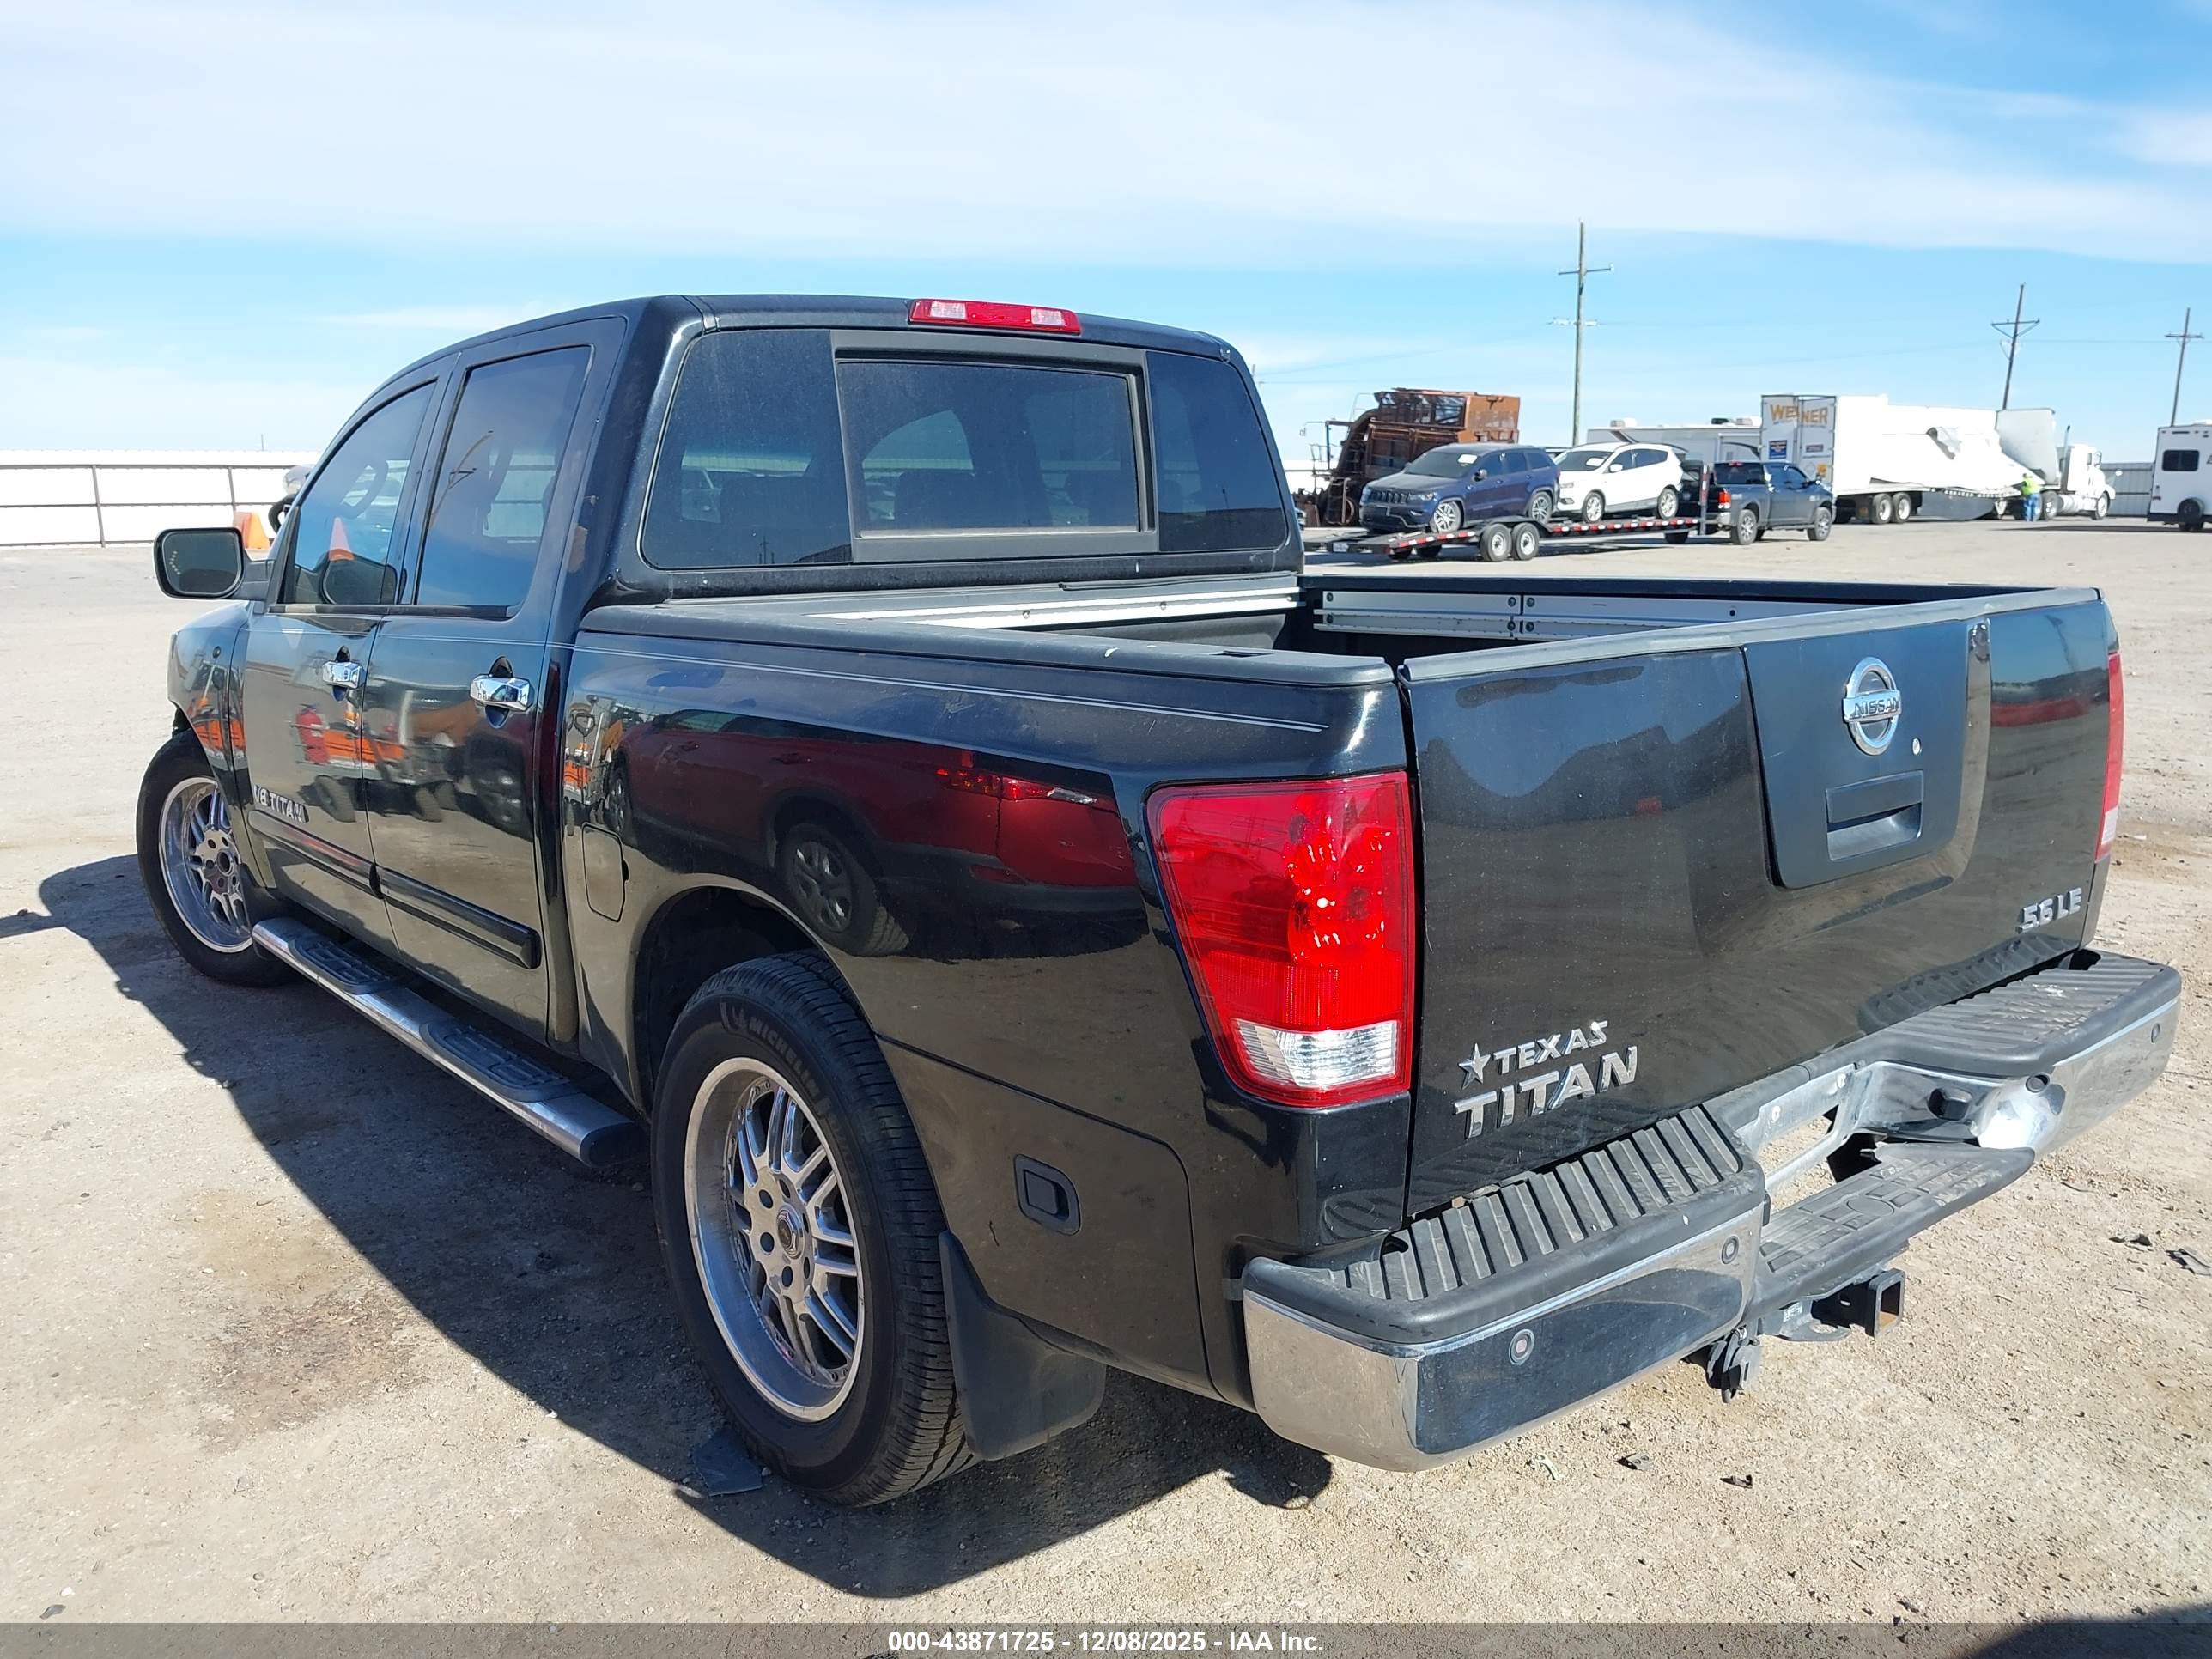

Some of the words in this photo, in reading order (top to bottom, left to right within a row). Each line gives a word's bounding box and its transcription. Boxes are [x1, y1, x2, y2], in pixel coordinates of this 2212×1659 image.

[1853, 697, 1899, 718] NISSAN
[253, 785, 269, 806] V8
[270, 793, 306, 823] TITAN
[2056, 887, 2082, 920] LE
[748, 1016, 821, 1097] MICHELIN
[1493, 1019, 1608, 1075] TEXAS
[1453, 1045, 1638, 1139] TITAN
